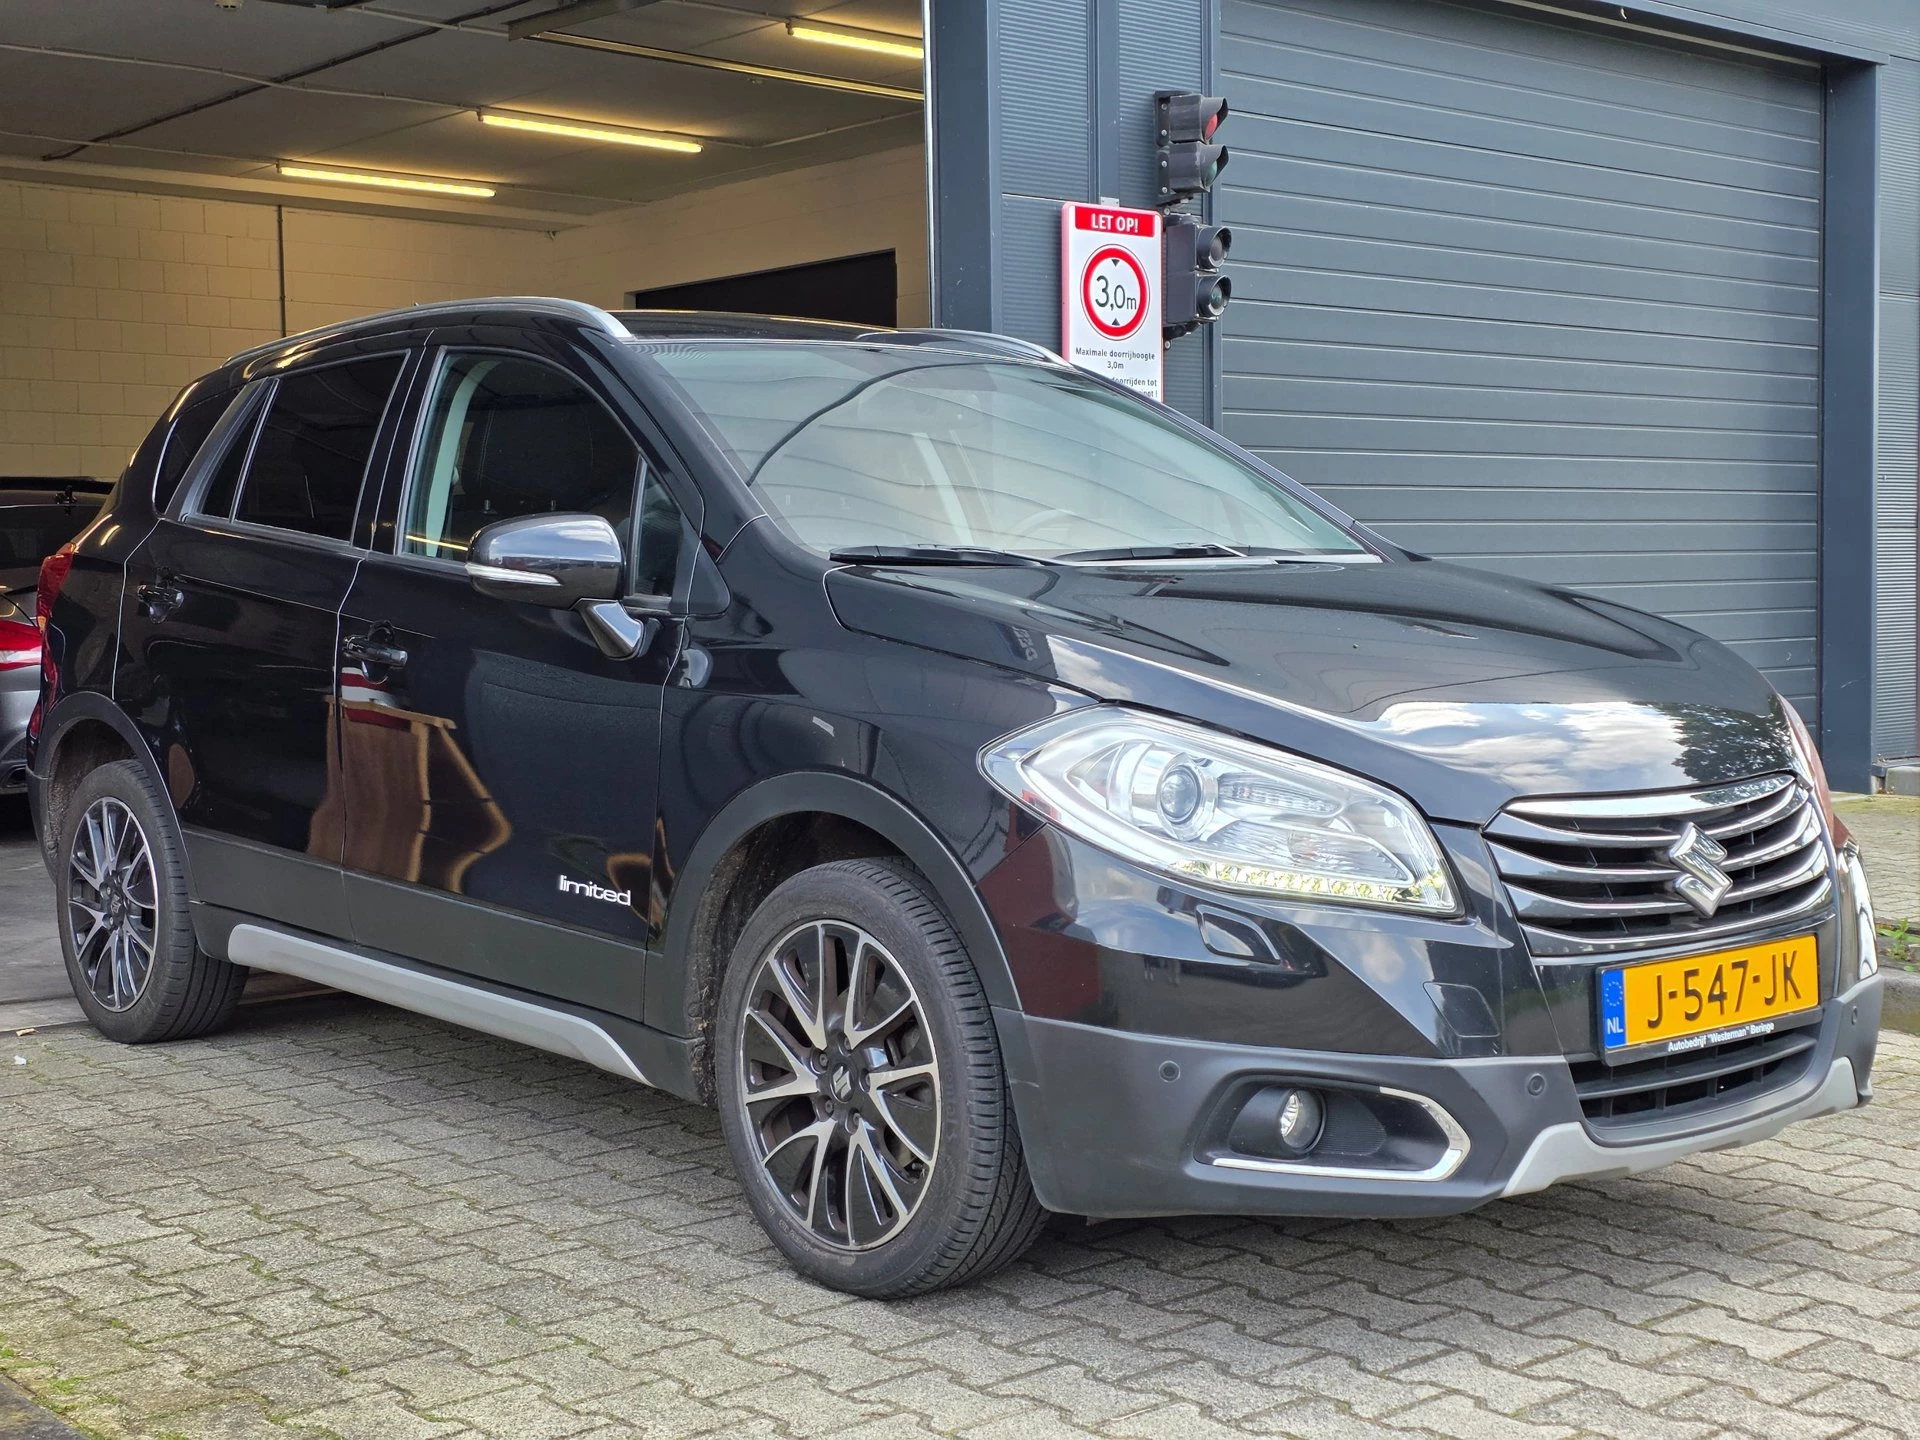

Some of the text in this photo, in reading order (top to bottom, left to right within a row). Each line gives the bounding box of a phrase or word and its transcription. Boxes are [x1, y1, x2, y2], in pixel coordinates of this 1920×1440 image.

[1091, 213, 1139, 233] LET OP!
[1095, 275, 1137, 312] 3,0m
[1075, 347, 1156, 361] Maximale doorrijhoogte
[1107, 361, 1124, 369] 3,0m
[1147, 379, 1157, 387] tot
[559, 874, 631, 906] limited
[1647, 950, 1802, 1029] J-547-JK
[1606, 1018, 1624, 1035] NL
[1668, 1037, 1707, 1053] Autobedrijf
